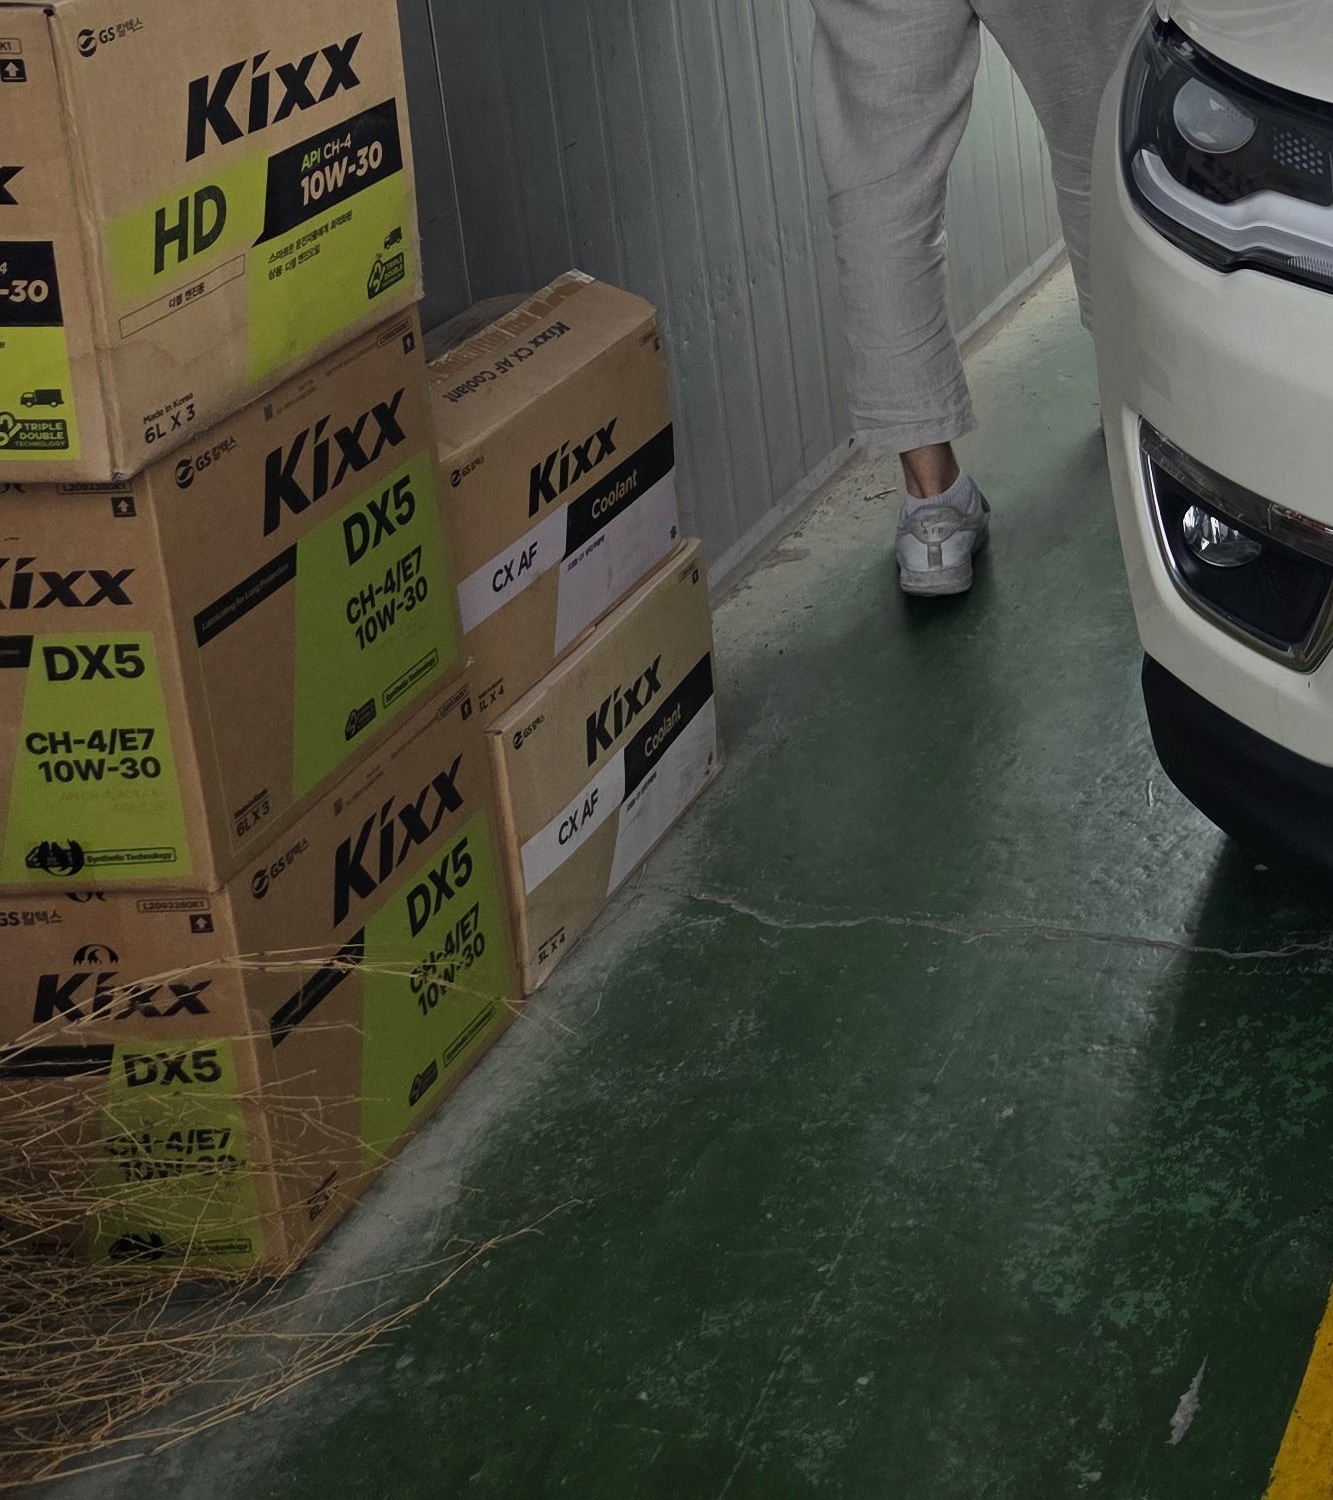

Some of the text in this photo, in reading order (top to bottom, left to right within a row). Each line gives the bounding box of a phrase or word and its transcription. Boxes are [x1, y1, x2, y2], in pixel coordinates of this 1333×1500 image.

[186, 32, 363, 163] Kixx
[301, 132, 352, 171] API CH-4
[301, 140, 383, 206] 10W-30
[154, 184, 228, 276] HD
[442, 321, 571, 403] Kixx CX AF Coolant
[19, 431, 65, 441] DOUBLE
[23, 421, 64, 432] TRIPLE
[143, 406, 163, 424] Made
[173, 392, 194, 410] Korea
[144, 421, 167, 445] 6L
[185, 402, 197, 422] 3
[263, 387, 407, 538] Kixx
[528, 416, 619, 518] Kixx
[342, 473, 416, 566] DX5
[591, 468, 638, 520] Coolant
[346, 545, 422, 625] CH-4/E7
[491, 561, 515, 594] CX
[517, 542, 539, 577] AF
[355, 576, 428, 650] 10W-30
[42, 643, 146, 682] DX5
[586, 654, 662, 768] Kixx
[644, 701, 682, 758] Coolant
[26, 728, 155, 756] CH-4/E7
[38, 755, 161, 783] 10W-30
[333, 752, 465, 929] Kixx
[557, 811, 580, 846] CX
[580, 788, 600, 827] AF
[124, 848, 173, 863] Technology
[406, 835, 473, 939] DX5
[33, 971, 213, 1024] Kixx
[122, 1049, 222, 1088] DX5
